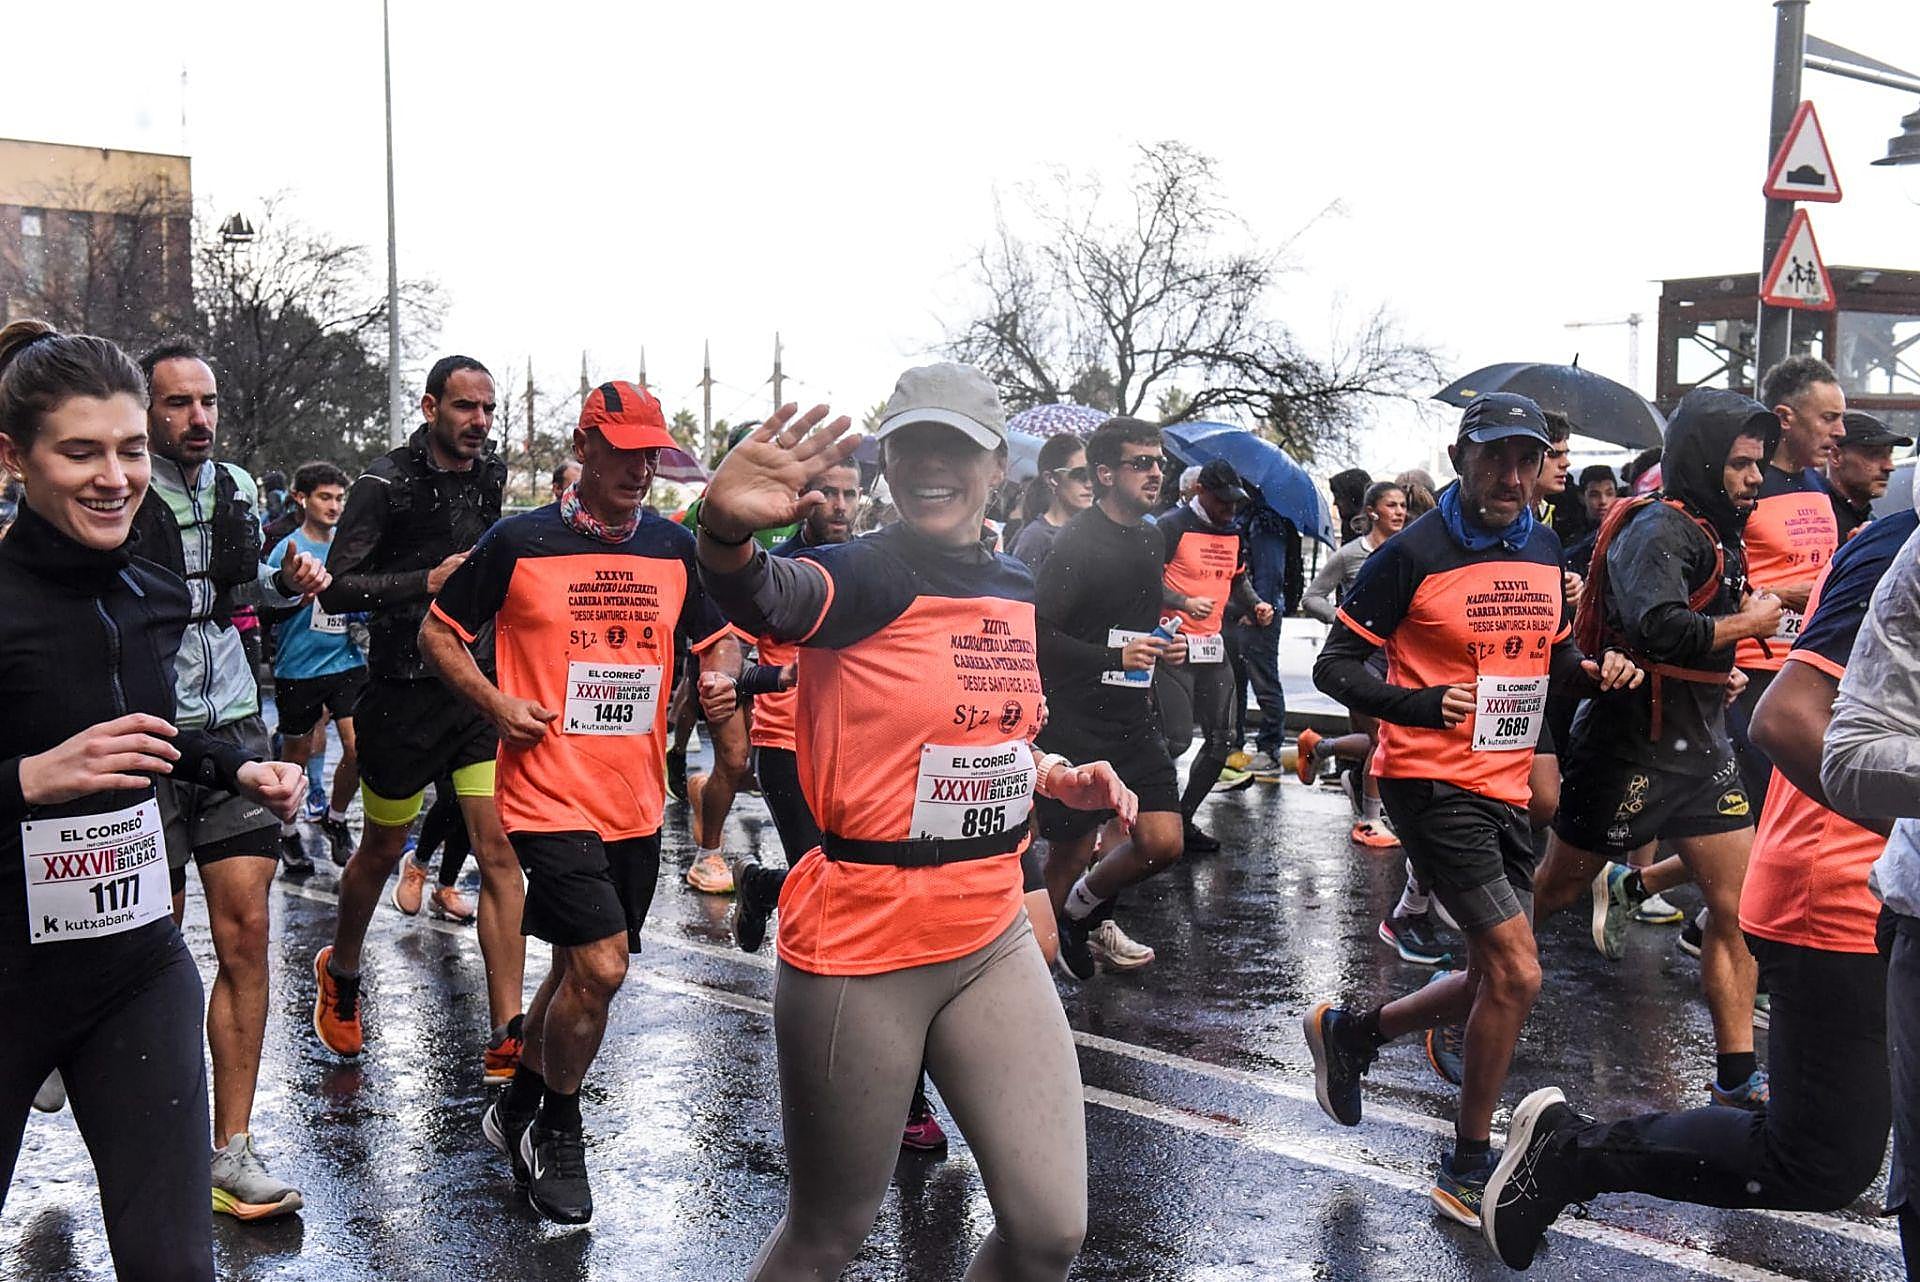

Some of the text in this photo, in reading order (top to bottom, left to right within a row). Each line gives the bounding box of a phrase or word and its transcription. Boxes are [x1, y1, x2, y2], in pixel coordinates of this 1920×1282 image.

[595, 570, 634, 581] XXXVII
[568, 582, 658, 594] NAZIOARTEKO LASTERKETA
[1494, 580, 1528, 591] XXXVII
[568, 596, 659, 607] CARRERA INTERNACIONAL
[596, 610, 627, 621] SANTURCE
[629, 611, 634, 620] A
[1466, 606, 1554, 618] CARRERA INTERNACIONAL
[1496, 620, 1526, 631] SANTURCE
[1526, 620, 1532, 630] A
[954, 654, 993, 670] CARRERA
[588, 670, 642, 680] EL CORREO
[576, 684, 616, 700] XXXVII
[988, 676, 1022, 692] SANTURCE
[1497, 684, 1537, 692] EL CORREO
[616, 692, 650, 700] BILBAO
[594, 704, 634, 722] 1443
[1486, 699, 1517, 714] XXXVII
[1516, 704, 1540, 712] BILBAO
[582, 722, 622, 731] kutxabank
[1495, 716, 1530, 736] 2689
[952, 752, 1016, 768] EL CORREO
[991, 772, 1028, 788] SANTURCE
[930, 778, 990, 801] XXXVII
[989, 783, 1027, 800] BILBAO
[962, 805, 1006, 837] 895
[60, 817, 142, 842] EL CORREO
[117, 836, 156, 858] SANTURCE
[43, 849, 115, 880] XXXVII
[117, 848, 156, 870] BILBAO
[89, 874, 140, 914] 1177
[65, 911, 135, 931] kutxabank
